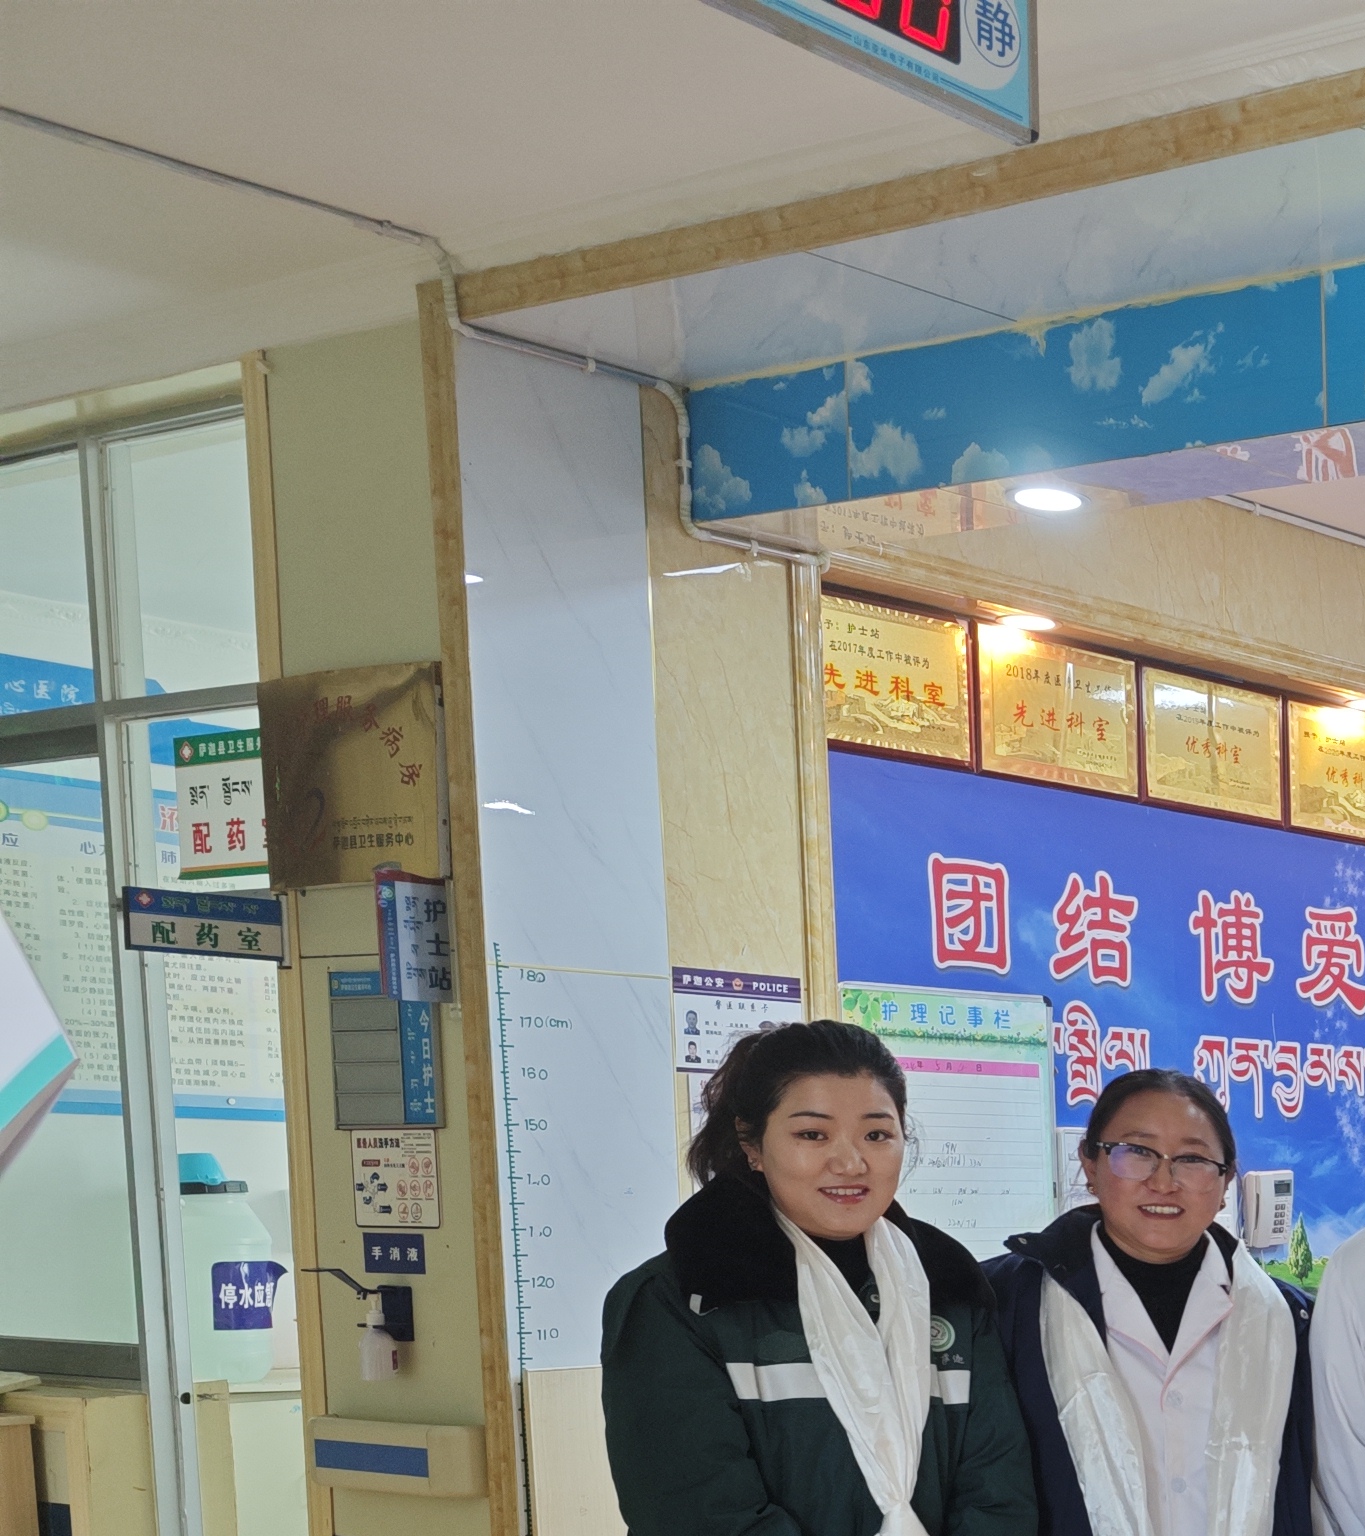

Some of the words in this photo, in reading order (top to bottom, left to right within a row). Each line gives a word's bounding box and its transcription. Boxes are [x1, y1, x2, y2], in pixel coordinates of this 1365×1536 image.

[975, 0, 1016, 58] 静
[823, 662, 946, 708] 先进科室
[1013, 700, 1110, 742] 先进科室
[1185, 735, 1242, 765] 优秀科室
[928, 853, 1138, 988] 团结
[151, 920, 262, 952] 配药室
[424, 899, 452, 991] 护士站
[682, 974, 724, 988] 萨迦公安
[752, 982, 789, 993] POLICE
[881, 1001, 1012, 1030] 护理记事栏
[419, 1009, 435, 1114] 今日护士
[521, 1066, 548, 1081] 160
[524, 1118, 548, 1131] 150
[527, 1173, 551, 1186] 10
[528, 1225, 552, 1238] 10
[371, 1246, 419, 1262] 手消液
[531, 1276, 555, 1289] 120
[537, 1327, 559, 1341] 110
